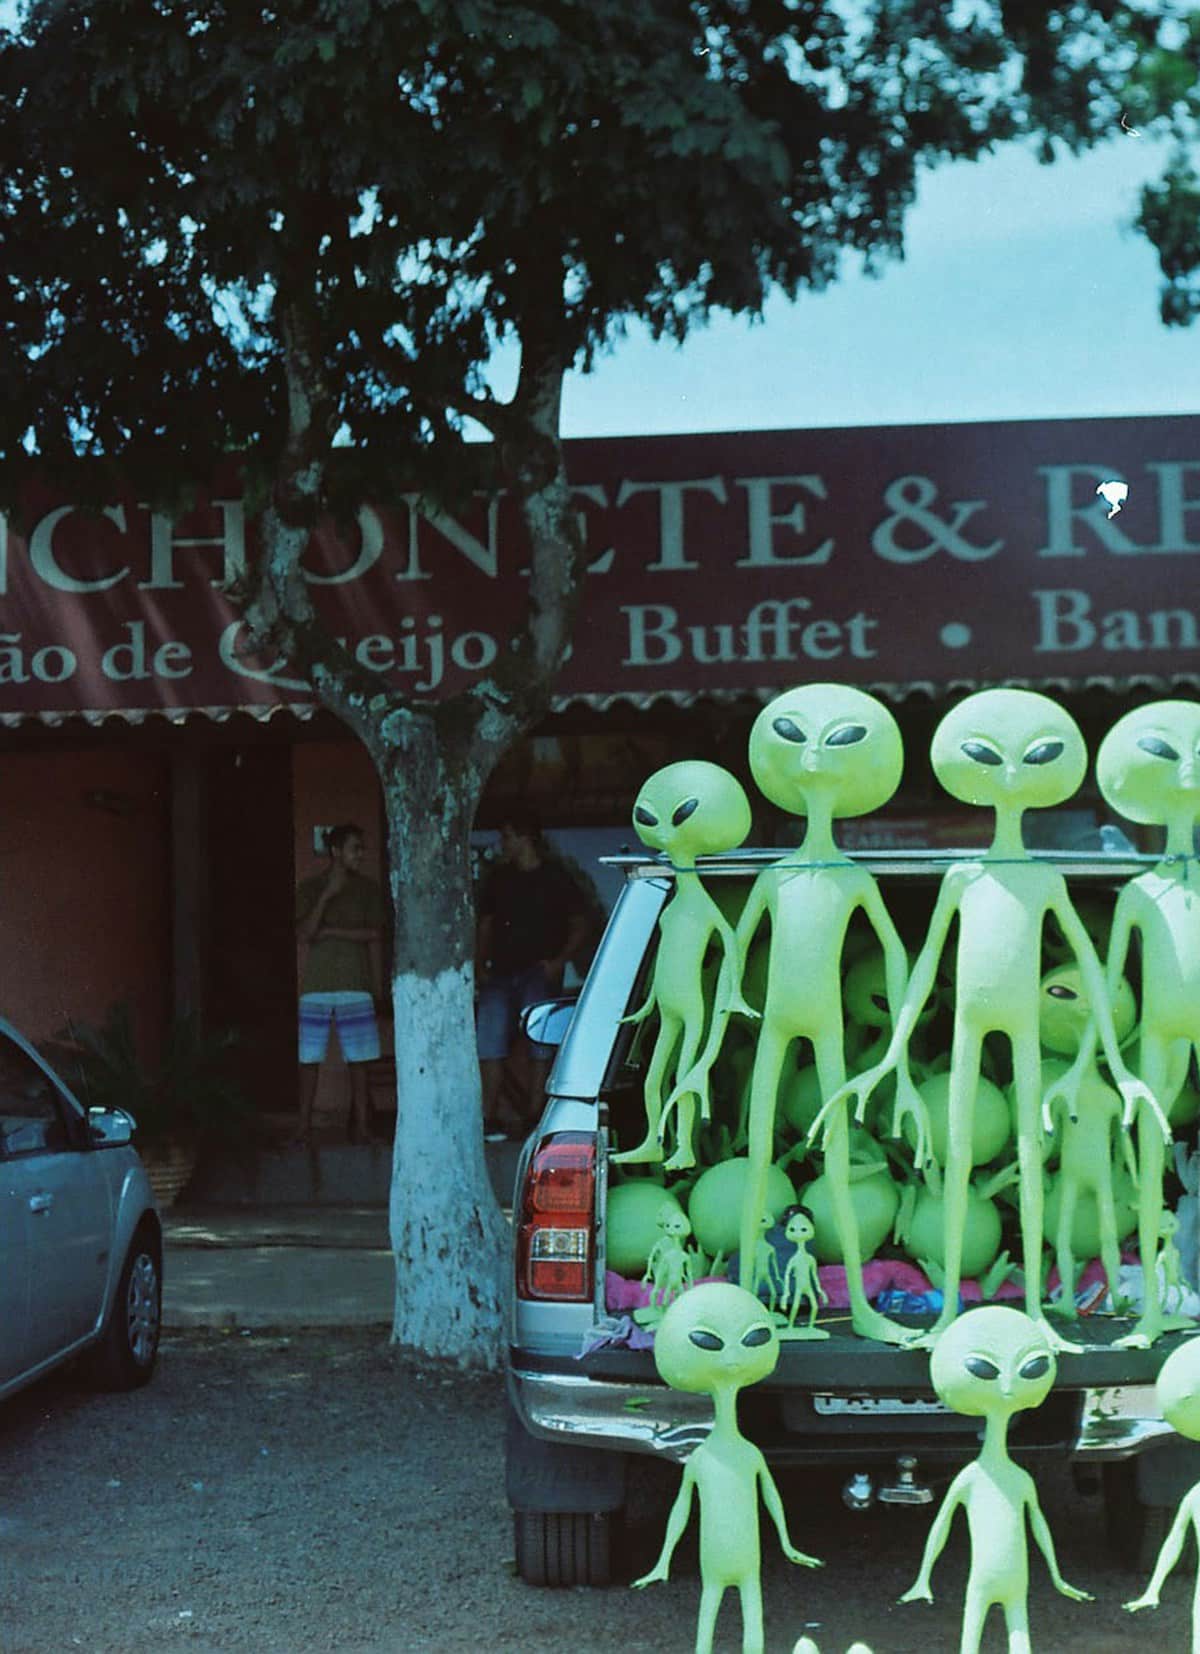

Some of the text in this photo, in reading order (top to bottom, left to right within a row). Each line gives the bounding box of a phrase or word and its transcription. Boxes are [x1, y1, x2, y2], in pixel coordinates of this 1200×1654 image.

[871, 475, 1005, 564] &
[101, 619, 194, 681] de
[219, 614, 498, 692] Qeijo
[619, 598, 878, 667] Buffet
